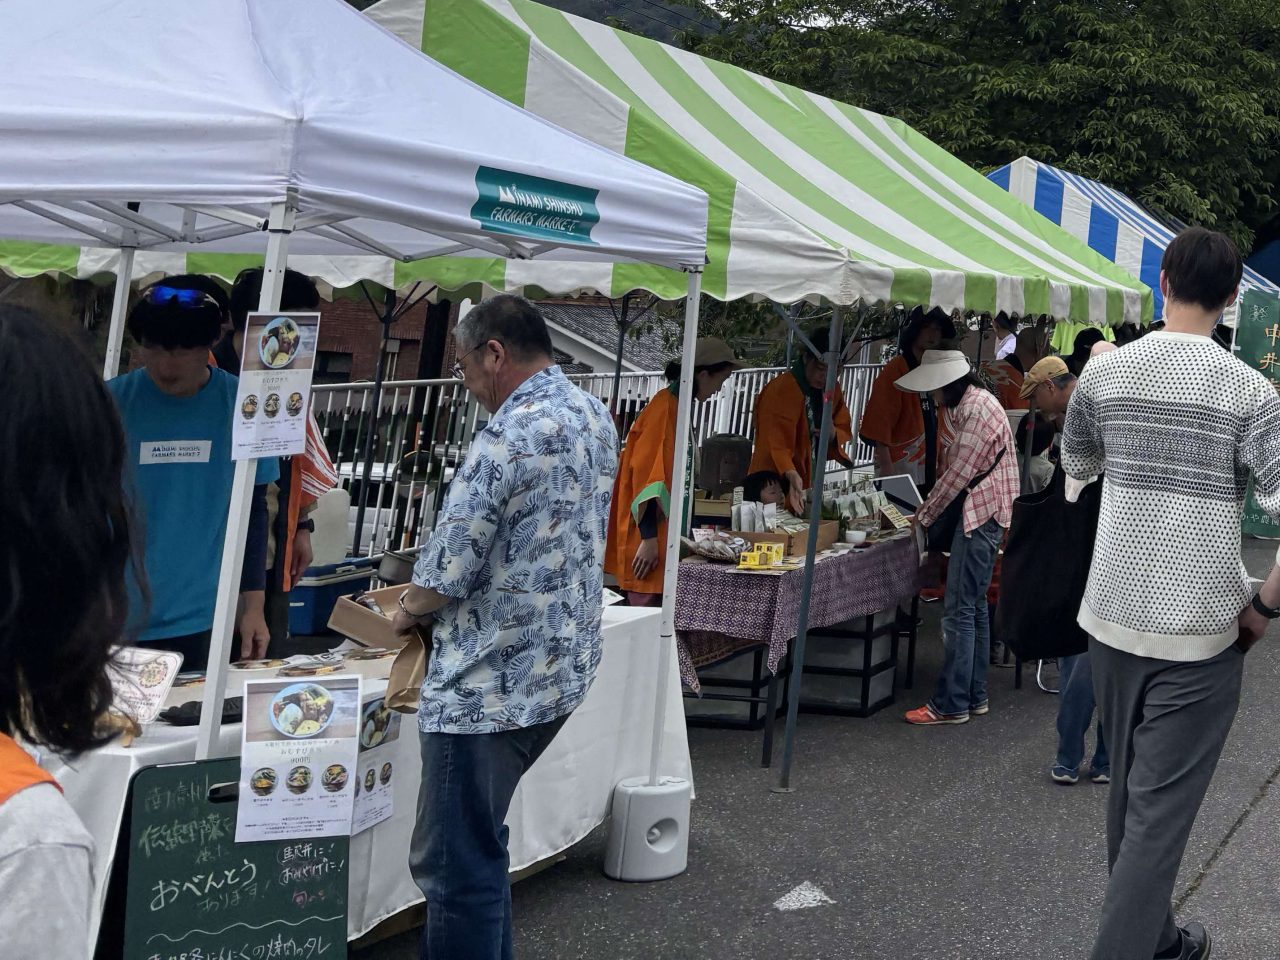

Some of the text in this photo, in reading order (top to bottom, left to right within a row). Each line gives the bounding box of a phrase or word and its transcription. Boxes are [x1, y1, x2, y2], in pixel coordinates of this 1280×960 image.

[490, 206, 534, 225] FARMARS
[545, 196, 584, 217] SHINSHU
[150, 858, 257, 912] おべんとう
